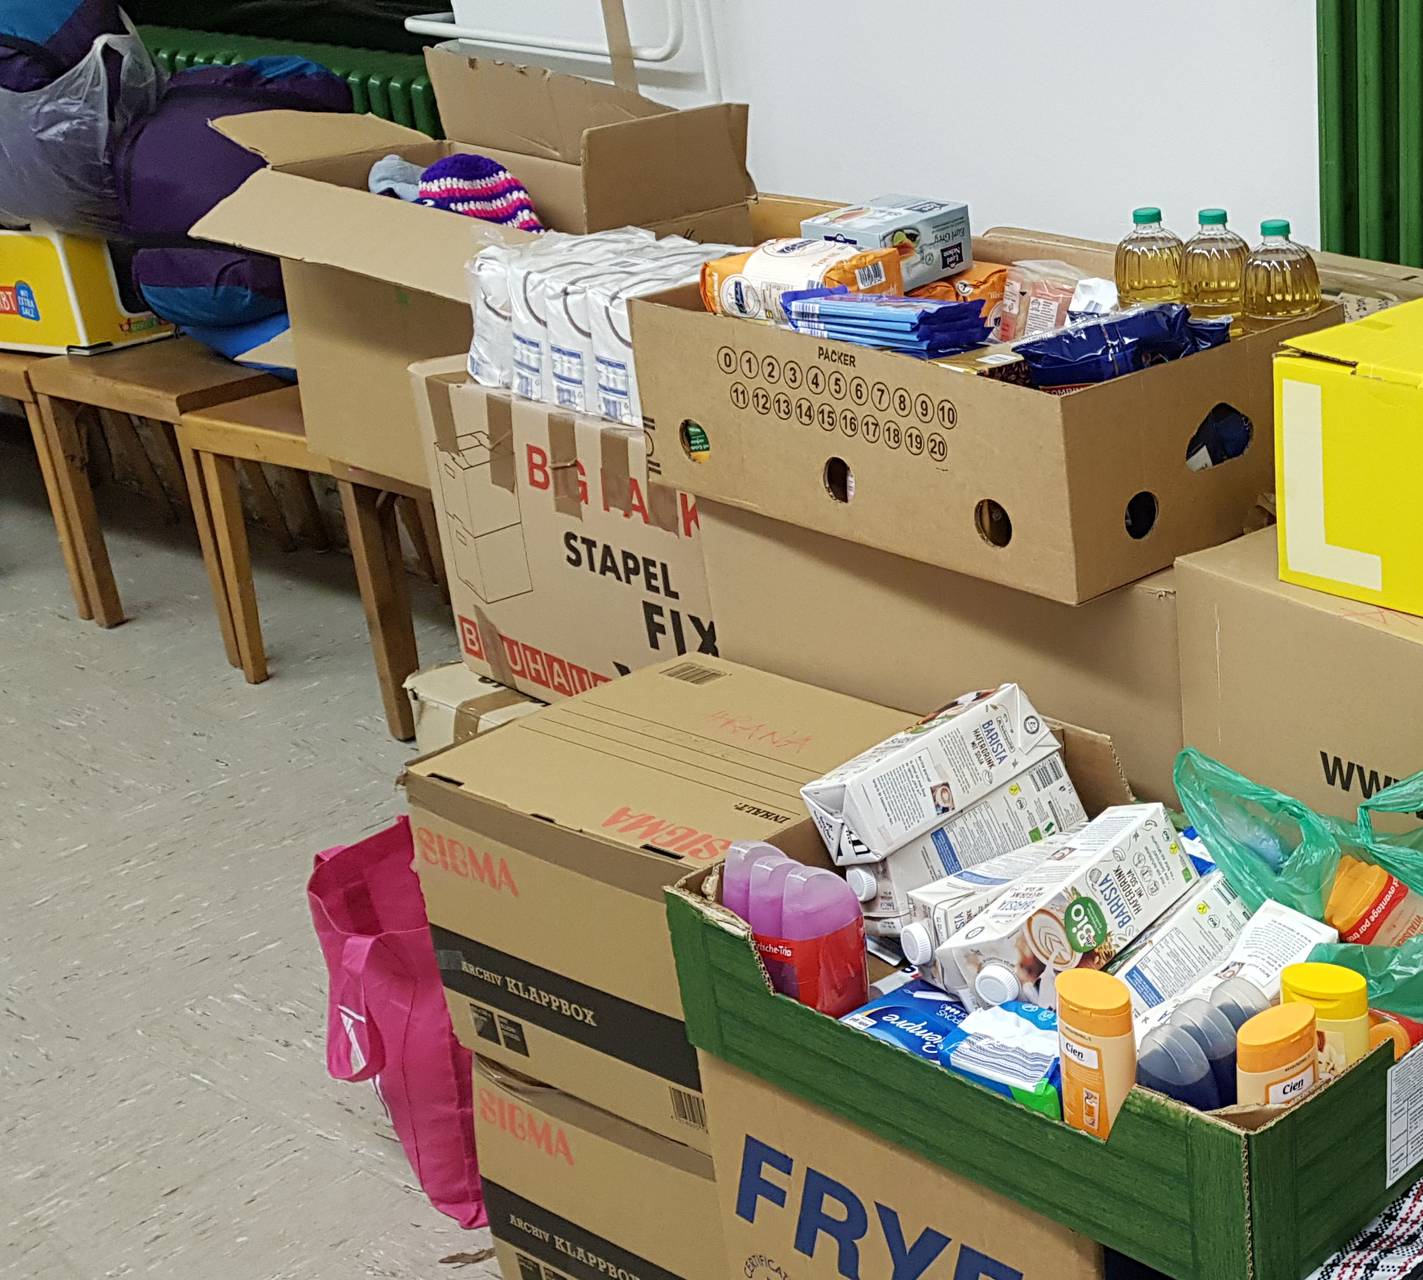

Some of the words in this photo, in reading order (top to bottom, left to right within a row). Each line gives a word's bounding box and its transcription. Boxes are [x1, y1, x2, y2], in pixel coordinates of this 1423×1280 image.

[818, 346, 856, 368] PACKER
[563, 531, 679, 600] STAPEL
[642, 600, 719, 658] FIX
[981, 719, 1008, 765] BARISTA
[416, 825, 520, 897] SIGMA
[601, 806, 732, 863] SIGMA
[1097, 872, 1132, 930] BARISTA
[1112, 864, 1144, 915] HAFERDRINK
[757, 942, 792, 957] rische-Trio
[461, 961, 502, 986] ARCHIV
[505, 976, 598, 1027] KLAPPBOX
[1065, 1041, 1084, 1060] Cien
[1282, 1077, 1304, 1096] Cien
[479, 1088, 575, 1167] SIGMA
[510, 1214, 550, 1242] ARCHIV
